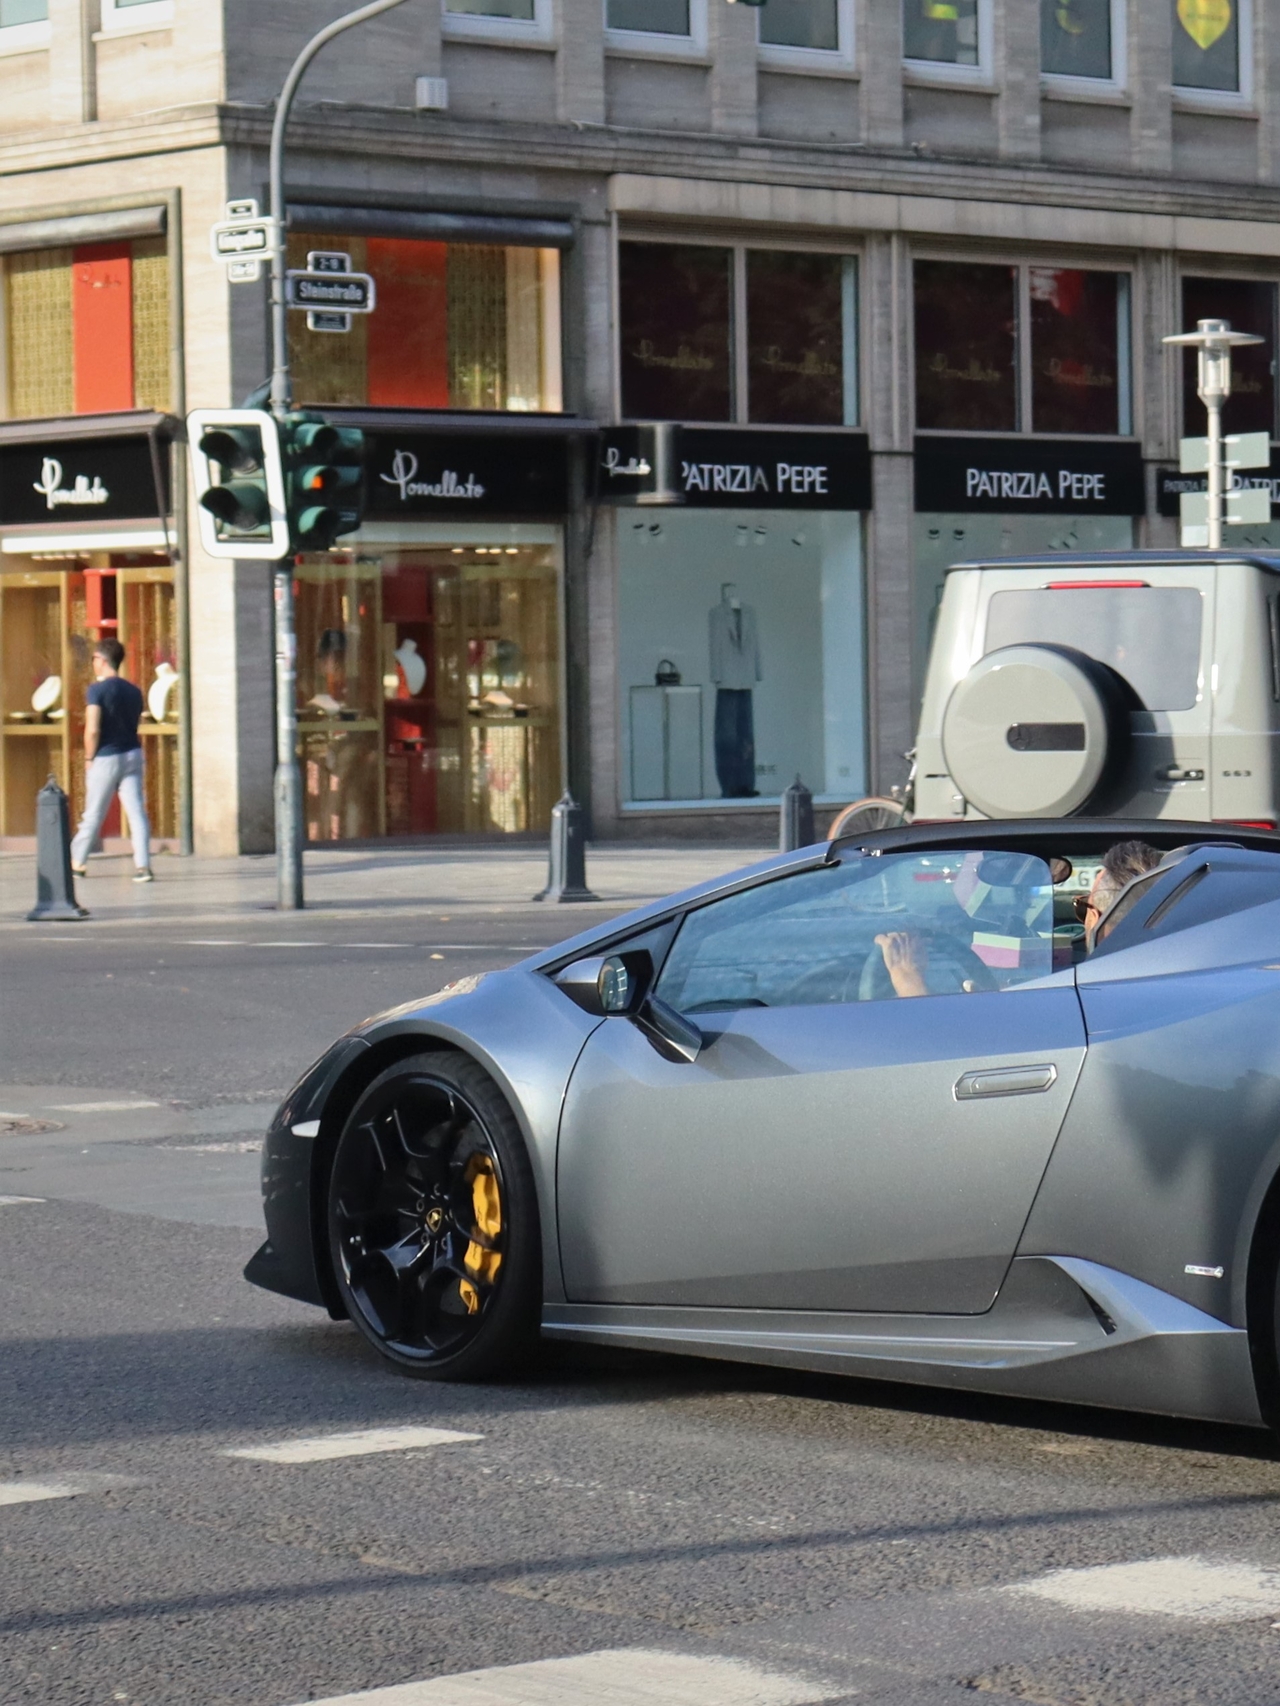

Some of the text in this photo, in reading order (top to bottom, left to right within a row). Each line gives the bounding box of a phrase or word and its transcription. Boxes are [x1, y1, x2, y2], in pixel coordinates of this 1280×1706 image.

[299, 281, 363, 301] Steinstraße
[379, 449, 486, 501] Pomellato
[776, 462, 829, 494] PEPE
[966, 468, 1106, 500] PATRIZIA PEPE
